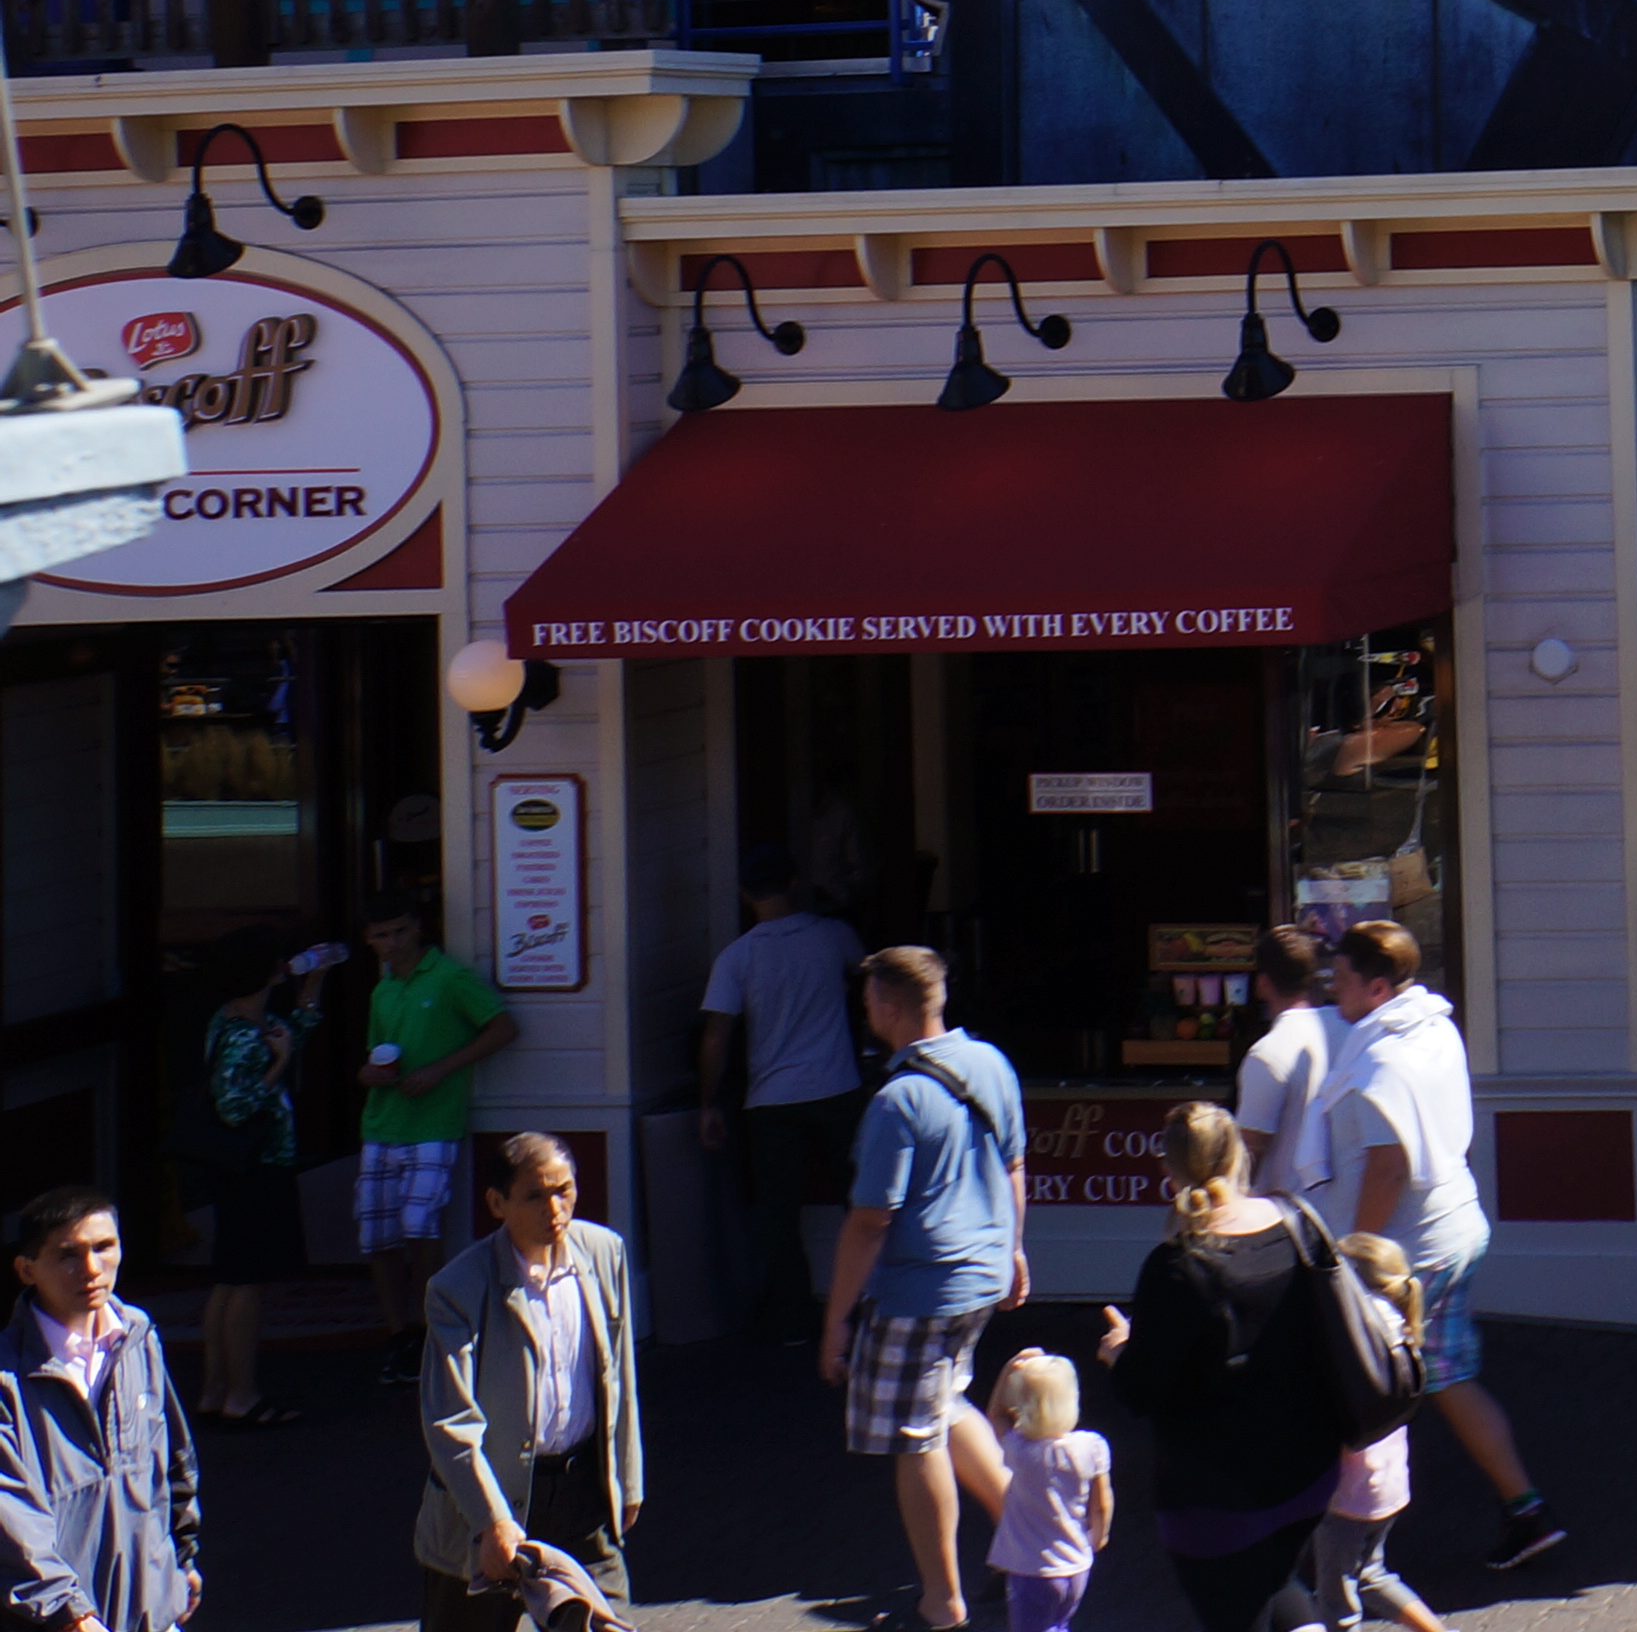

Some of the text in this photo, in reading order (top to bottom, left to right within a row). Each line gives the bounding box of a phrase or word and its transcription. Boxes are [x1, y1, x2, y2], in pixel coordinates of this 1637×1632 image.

[127, 319, 187, 354] Lotus
[163, 485, 366, 520] CORNER
[532, 607, 1294, 646] FREE BISCOFF COOKIE SERVED WITH EVERY COFFEE
[1083, 1174, 1149, 1202] CUP
